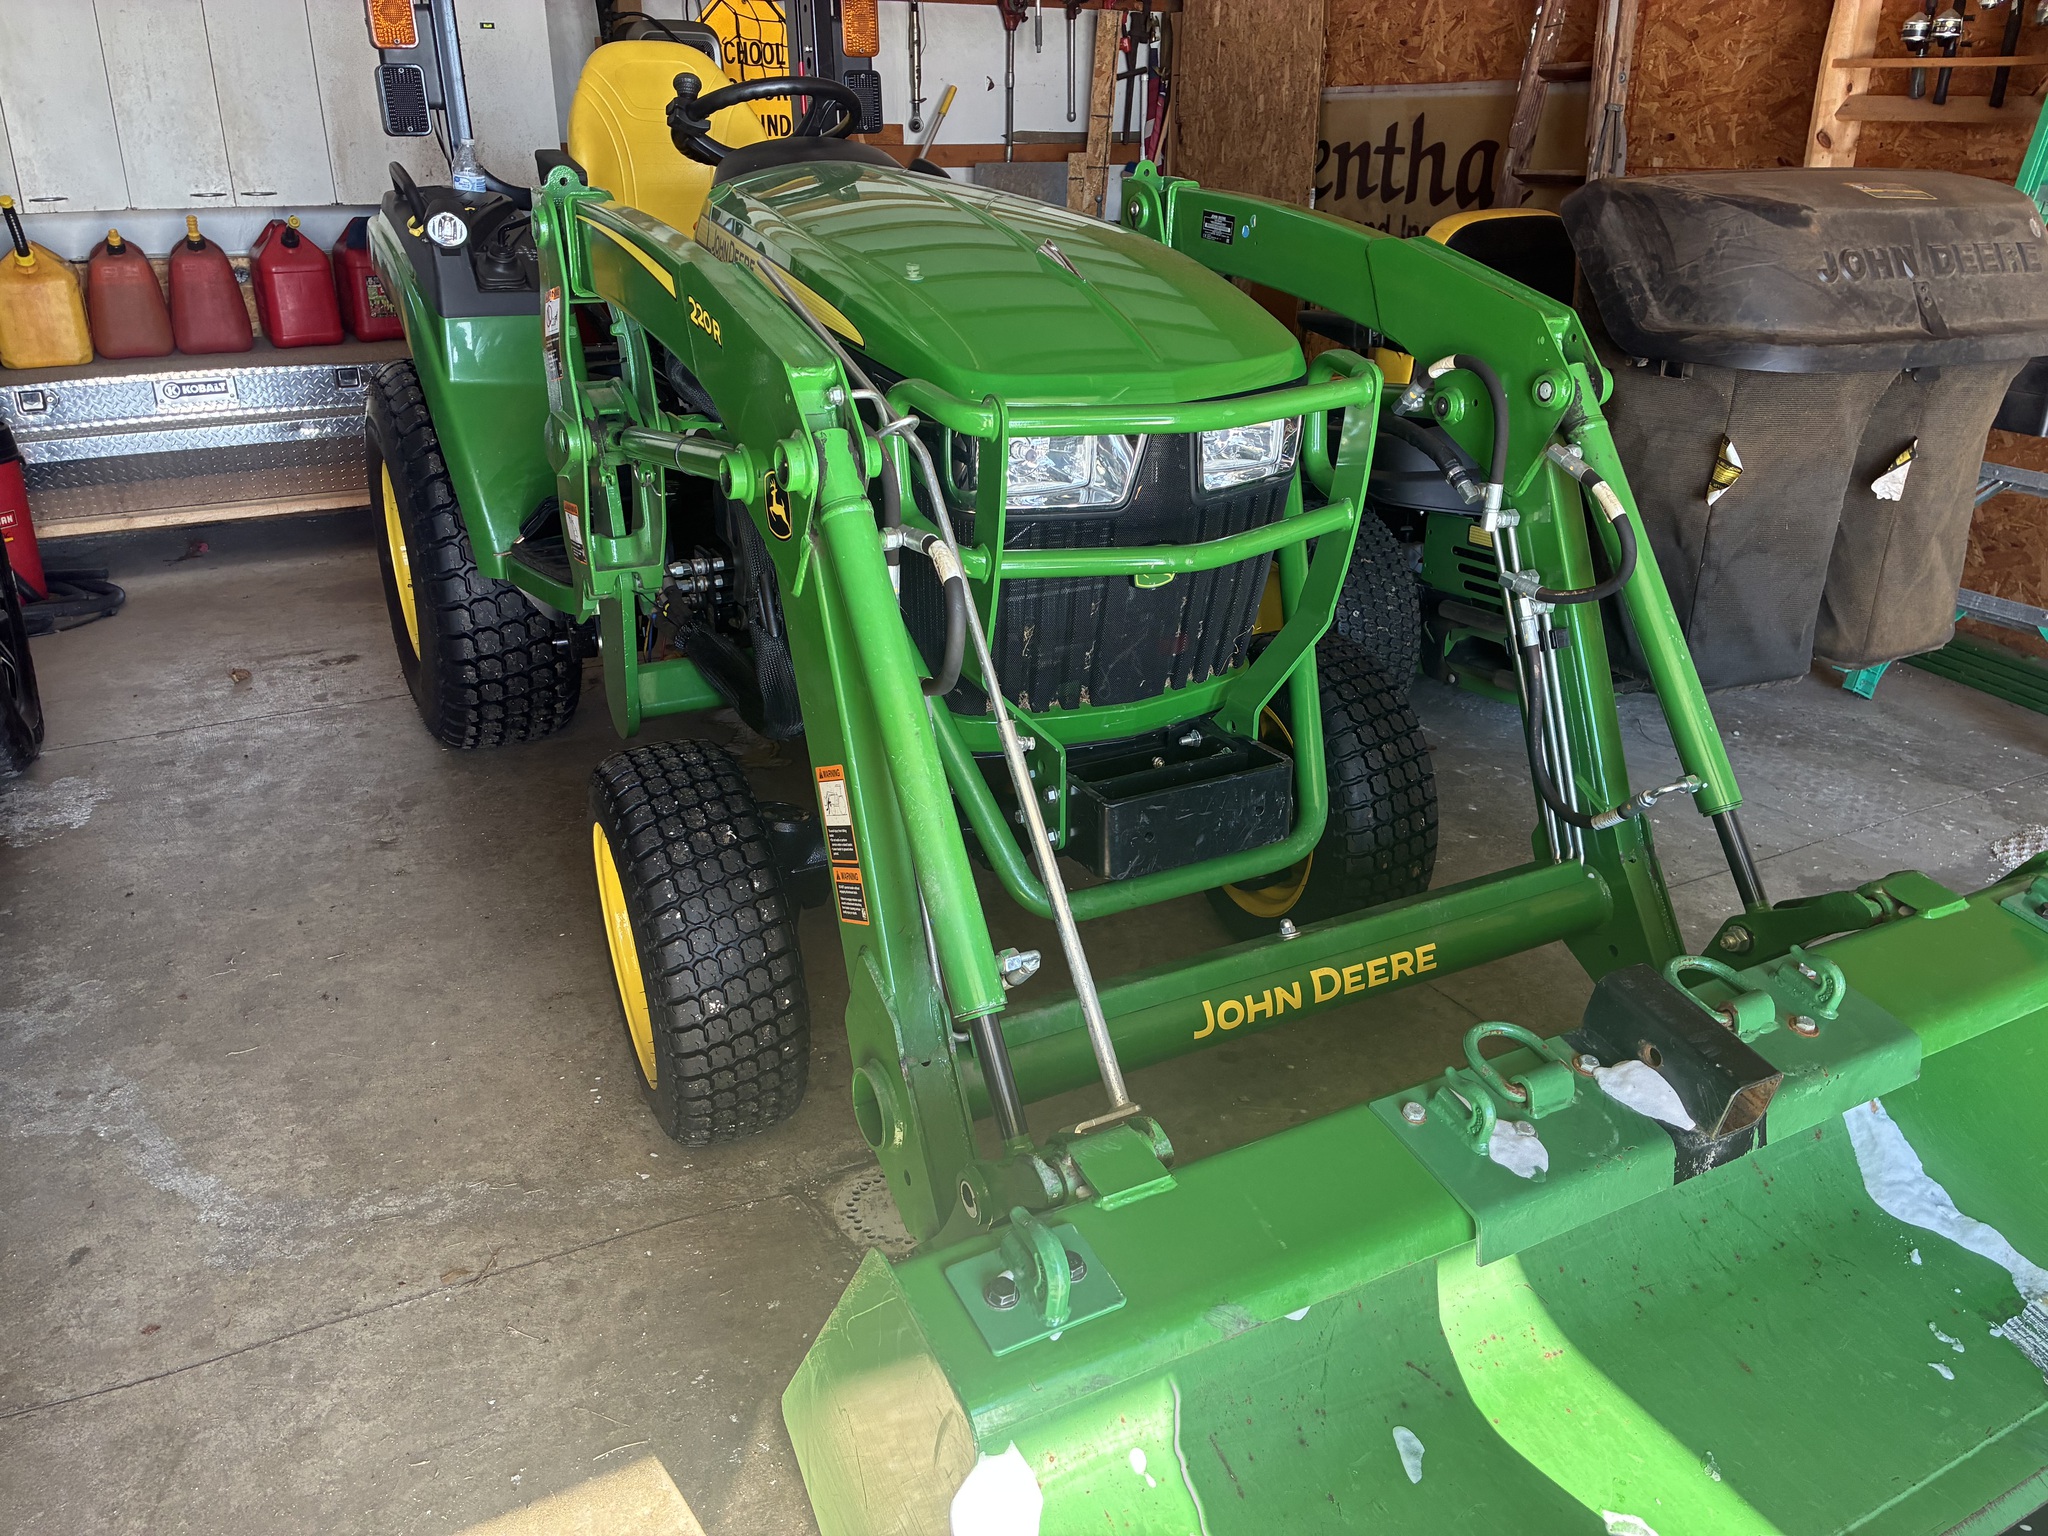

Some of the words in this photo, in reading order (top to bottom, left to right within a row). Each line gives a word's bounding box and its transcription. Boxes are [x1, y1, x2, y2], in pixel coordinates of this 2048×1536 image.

[723, 41, 785, 65] CHOOL
[761, 114, 791, 137] IND
[1315, 112, 1501, 210] entha
[1816, 245, 1921, 284] JOHN
[1926, 241, 2043, 278] DEERE
[688, 295, 723, 349] 220R
[181, 382, 226, 395] KOBALT
[0, 514, 14, 526] AN
[1193, 981, 1302, 1040] JOHN
[1309, 942, 1438, 1004] DEERE
